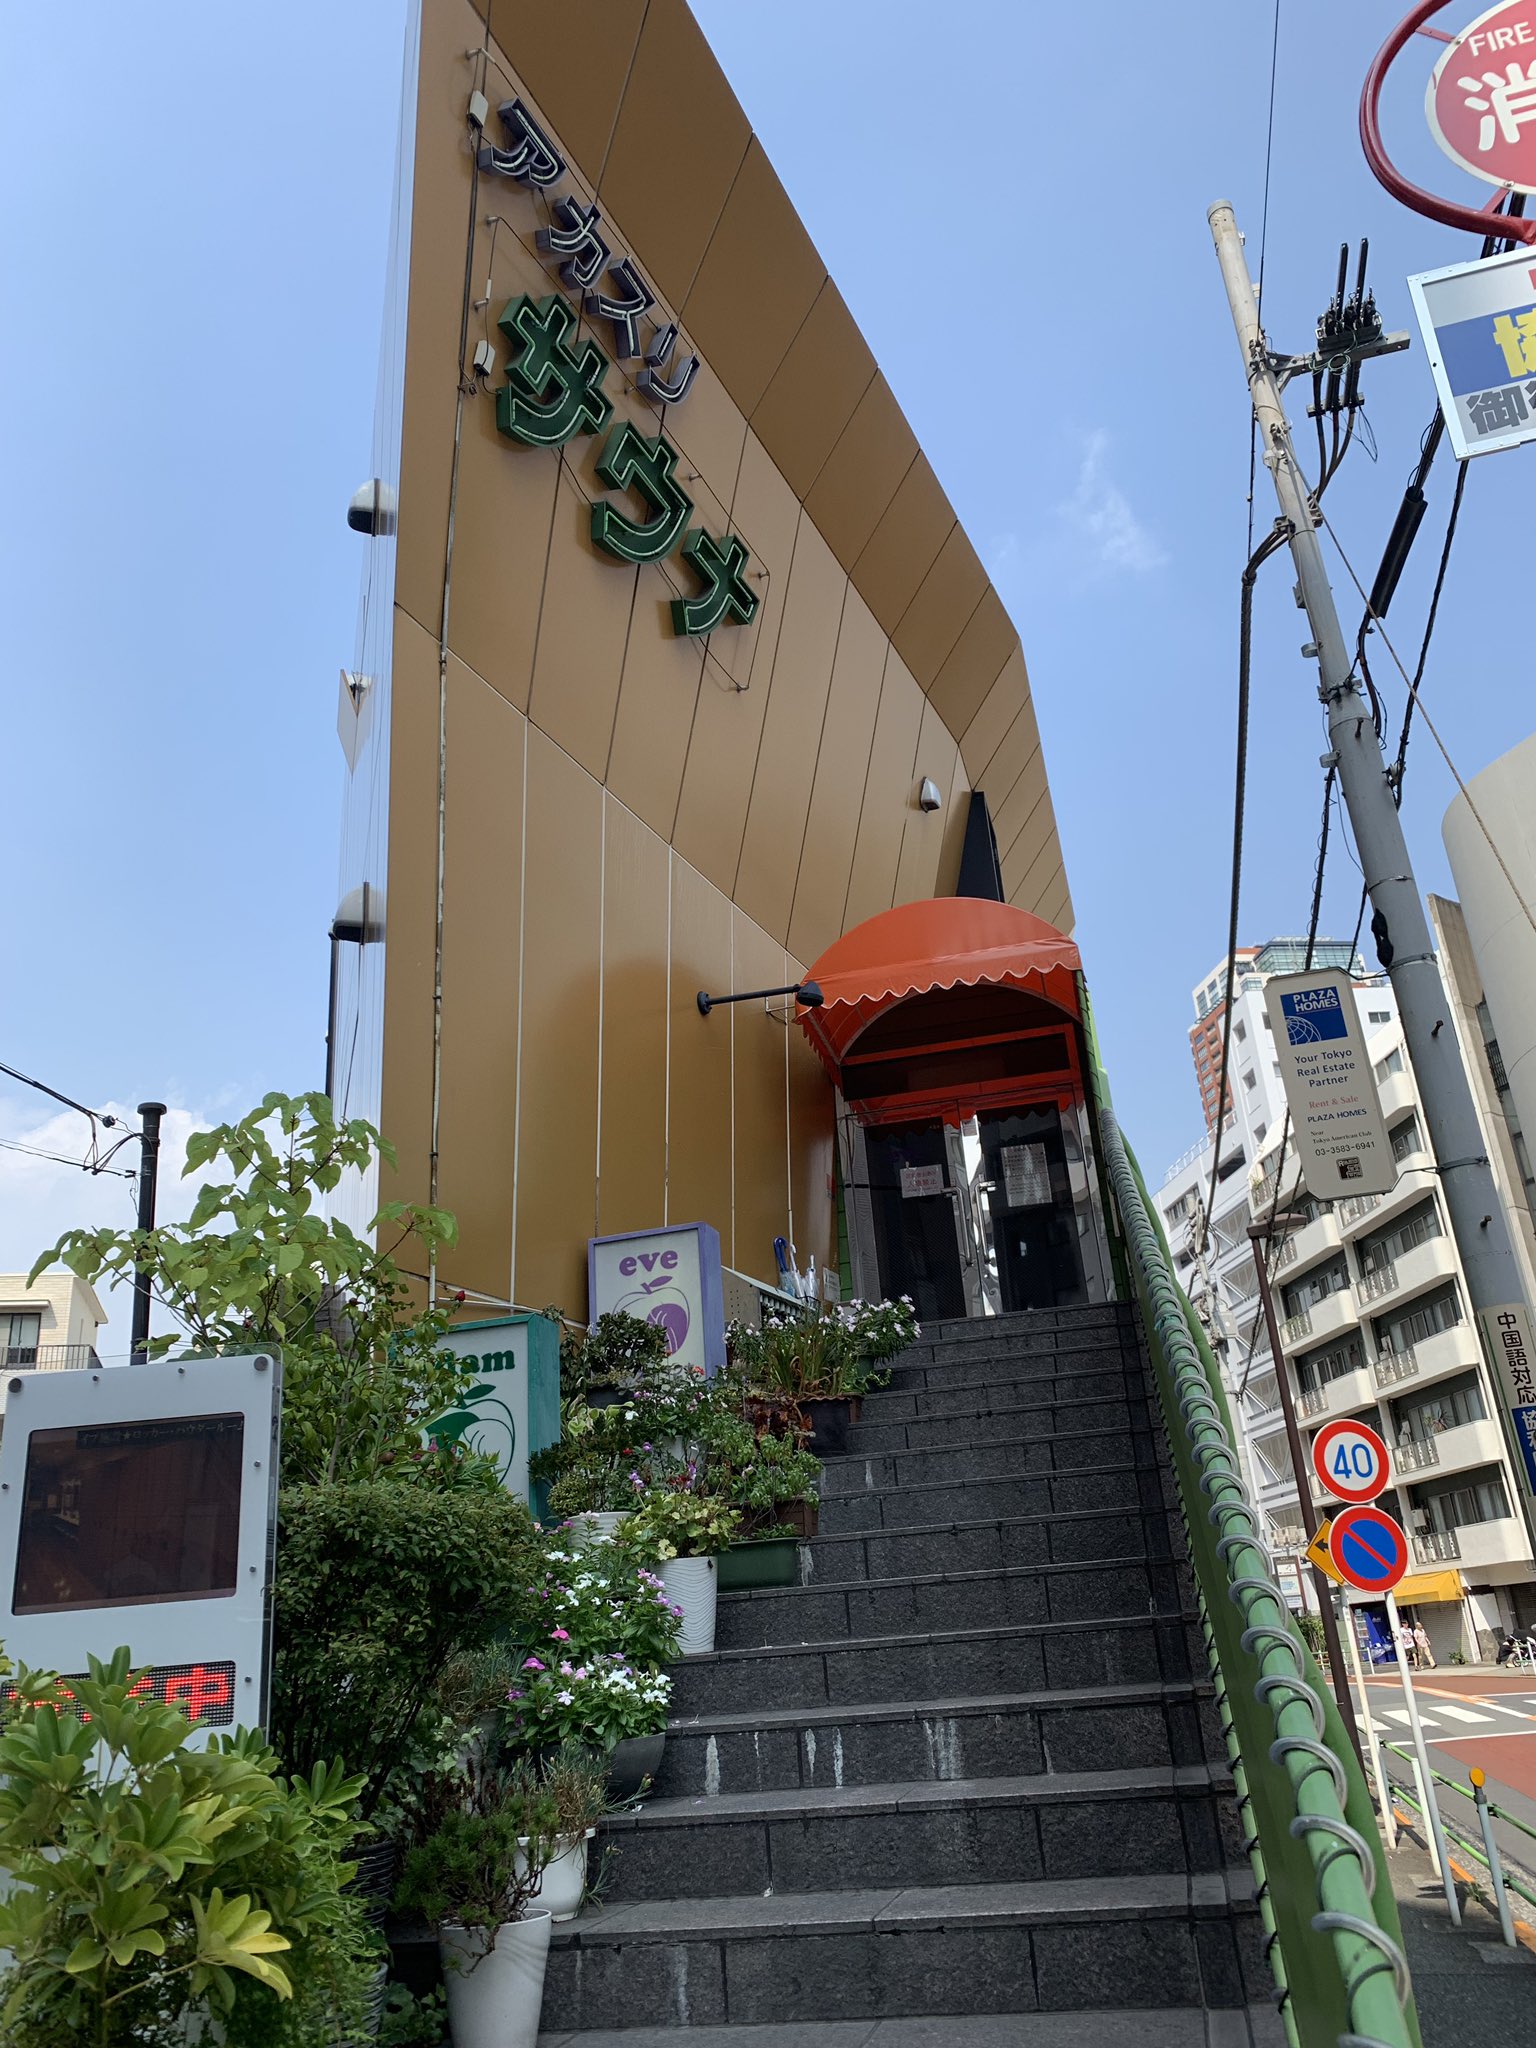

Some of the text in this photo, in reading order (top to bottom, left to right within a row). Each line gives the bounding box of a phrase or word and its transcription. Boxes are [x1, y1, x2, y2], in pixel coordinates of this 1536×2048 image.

[1468, 21, 1535, 57] FIRE
[1457, 60, 1536, 151] 消
[479, 97, 700, 405] アカスリ
[1466, 381, 1536, 435] 御
[495, 292, 760, 637] サウナ
[1293, 989, 1336, 1003] PLAZA
[1295, 998, 1339, 1012] HOMES
[1295, 1049, 1352, 1064] Your Tokyo
[1297, 1062, 1355, 1077] Real Estate
[1309, 1076, 1348, 1087] Partner
[1309, 1100, 1329, 1109] Rent
[1340, 1095, 1359, 1104] Sale
[1307, 1108, 1367, 1123] PLAZA HOMES
[1331, 1133, 1358, 1141] American
[1315, 1141, 1375, 1156] 03-3583-6941
[618, 1250, 679, 1277] eve
[1497, 1311, 1536, 1405] 中国語対応
[1333, 1443, 1373, 1479] 40
